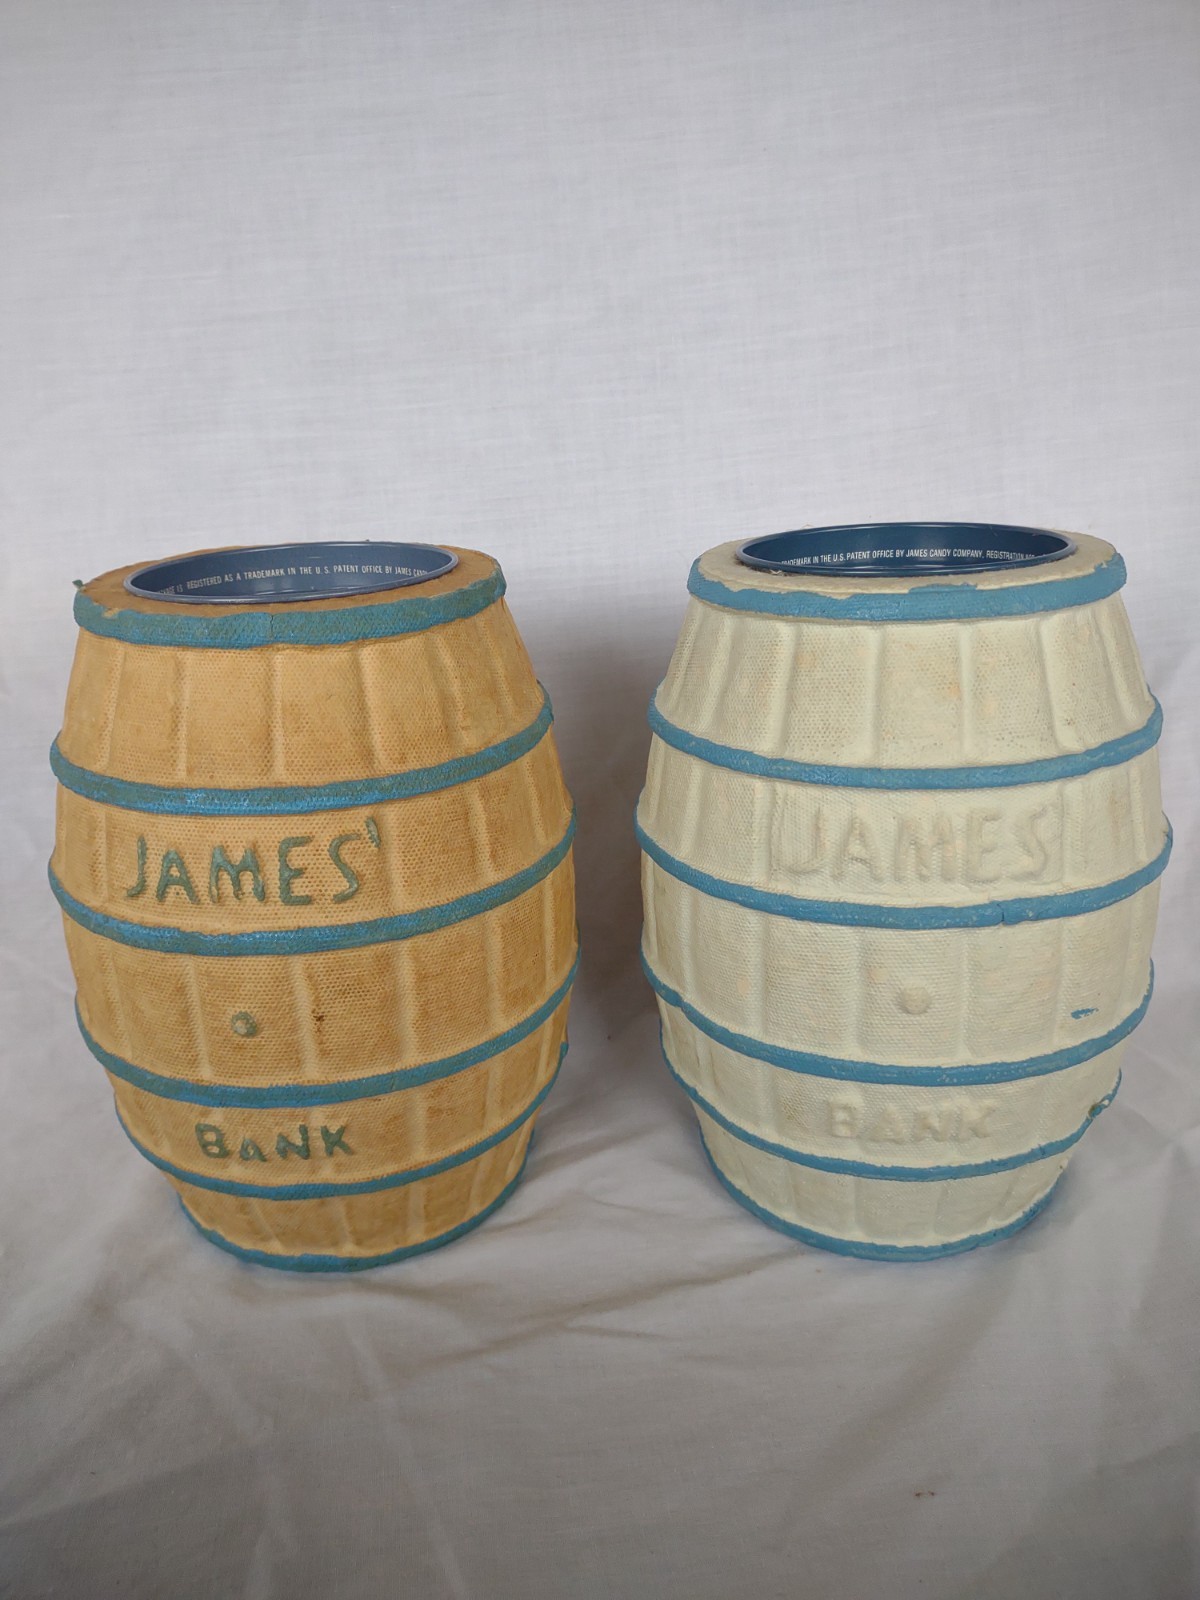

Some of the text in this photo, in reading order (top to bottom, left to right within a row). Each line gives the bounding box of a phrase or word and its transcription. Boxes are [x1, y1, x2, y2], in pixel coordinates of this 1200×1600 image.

[812, 555, 820, 564] IN
[820, 553, 832, 563] THE
[832, 552, 846, 562] U.S.
[846, 550, 871, 561] PATENT
[872, 549, 894, 559] OFFICE
[895, 549, 904, 558] BY
[905, 548, 928, 558] JAMES
[929, 548, 952, 558] CANDY
[186, 575, 222, 590] REGISTERED
[224, 573, 234, 583] AS
[236, 572, 242, 581] A
[244, 568, 285, 580] TRADEMARK
[287, 567, 296, 575] IN
[299, 566, 312, 575] THE
[333, 564, 359, 574] PATENT
[361, 564, 383, 574] OFFICE
[385, 565, 393, 574] BY
[395, 566, 412, 576] JAMES
[126, 816, 382, 906] JAMES'
[829, 1093, 997, 1145] BANK
[195, 1123, 353, 1162] BANK
